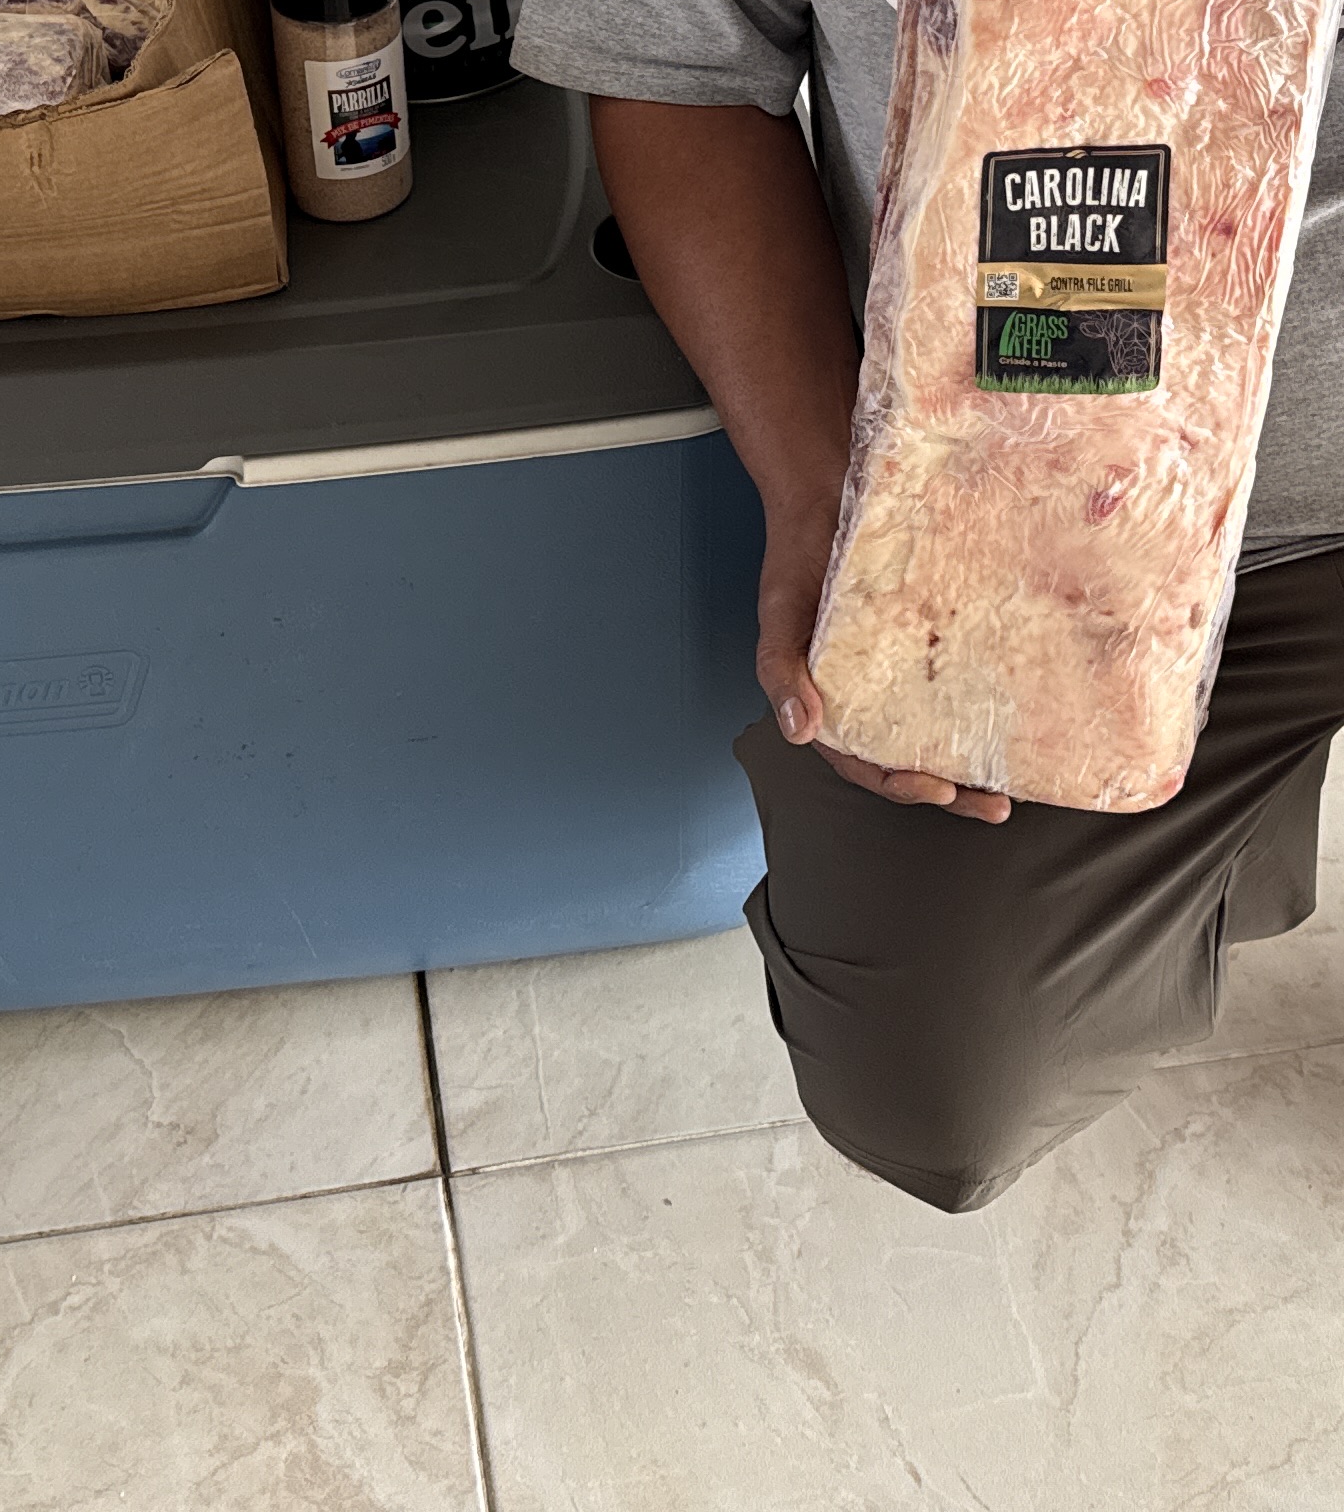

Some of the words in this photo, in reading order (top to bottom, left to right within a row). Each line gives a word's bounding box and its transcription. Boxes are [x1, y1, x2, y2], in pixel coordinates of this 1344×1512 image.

[331, 80, 390, 114] PARRILLA
[1004, 167, 1149, 212] CAROLINA
[1029, 213, 1124, 253] BLACK
[1050, 276, 1085, 292] CONTRA
[1107, 278, 1133, 292] GRILL
[1015, 313, 1068, 339] GRASS
[1023, 337, 1052, 359] FED
